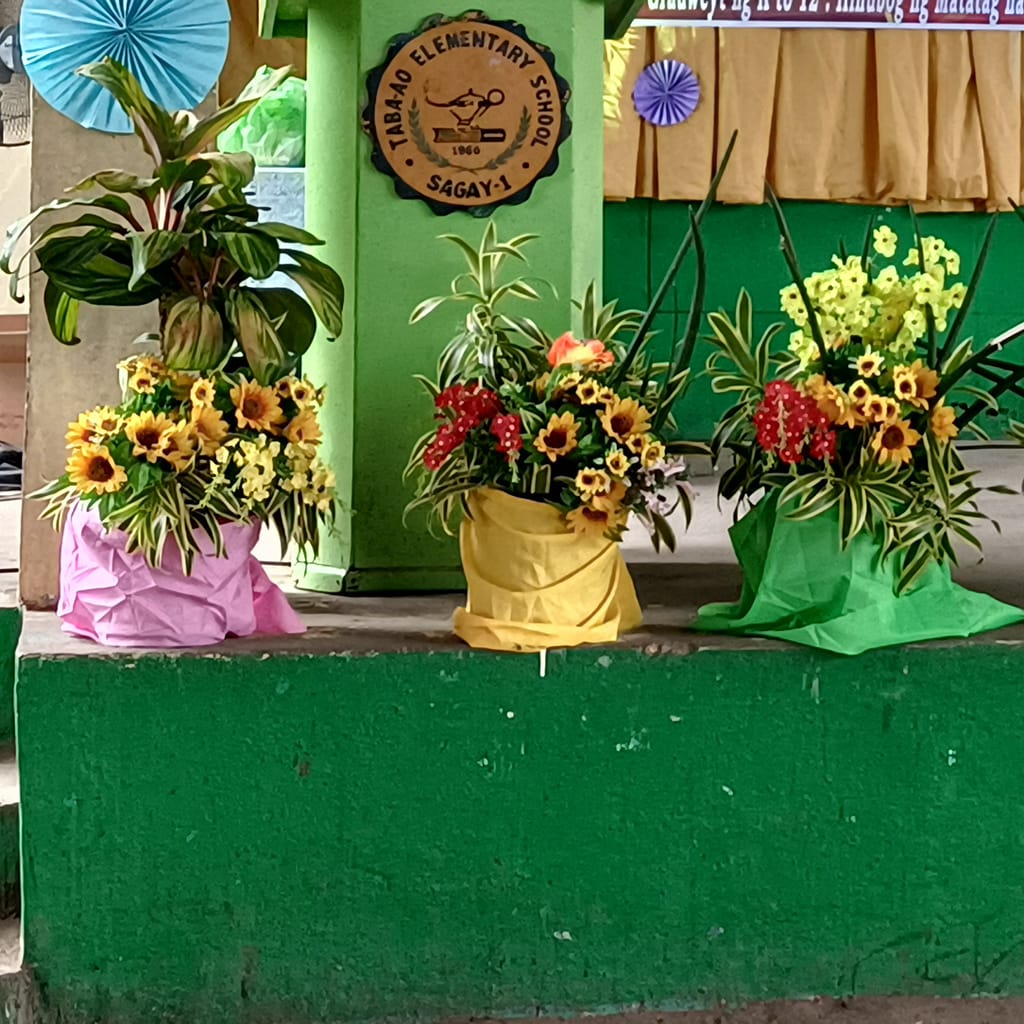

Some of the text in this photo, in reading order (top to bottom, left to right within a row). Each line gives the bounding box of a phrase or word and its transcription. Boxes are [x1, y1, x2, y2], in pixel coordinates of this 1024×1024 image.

[383, 30, 554, 151] TABA-AO ELEMENTARY SCHOOL
